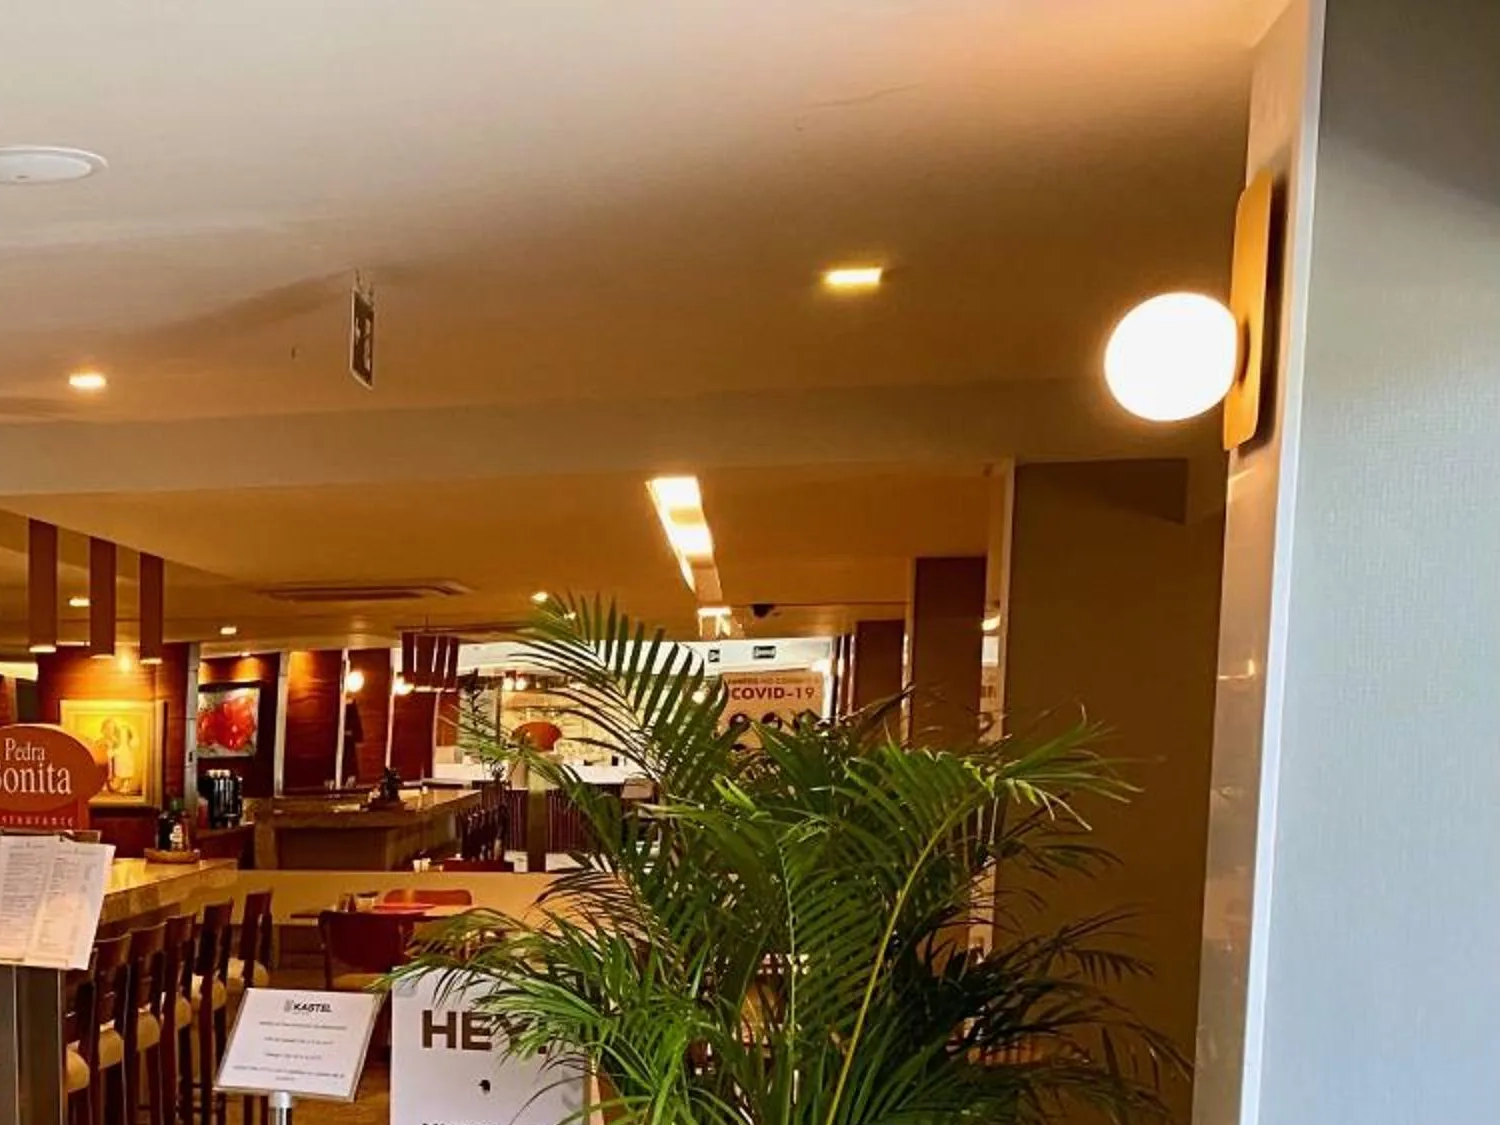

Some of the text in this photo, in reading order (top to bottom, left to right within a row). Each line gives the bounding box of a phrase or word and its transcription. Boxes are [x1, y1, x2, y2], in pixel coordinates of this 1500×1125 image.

[731, 686, 815, 700] COVID-19
[4, 738, 46, 762] Pedra
[293, 1002, 332, 1013] KASTEL
